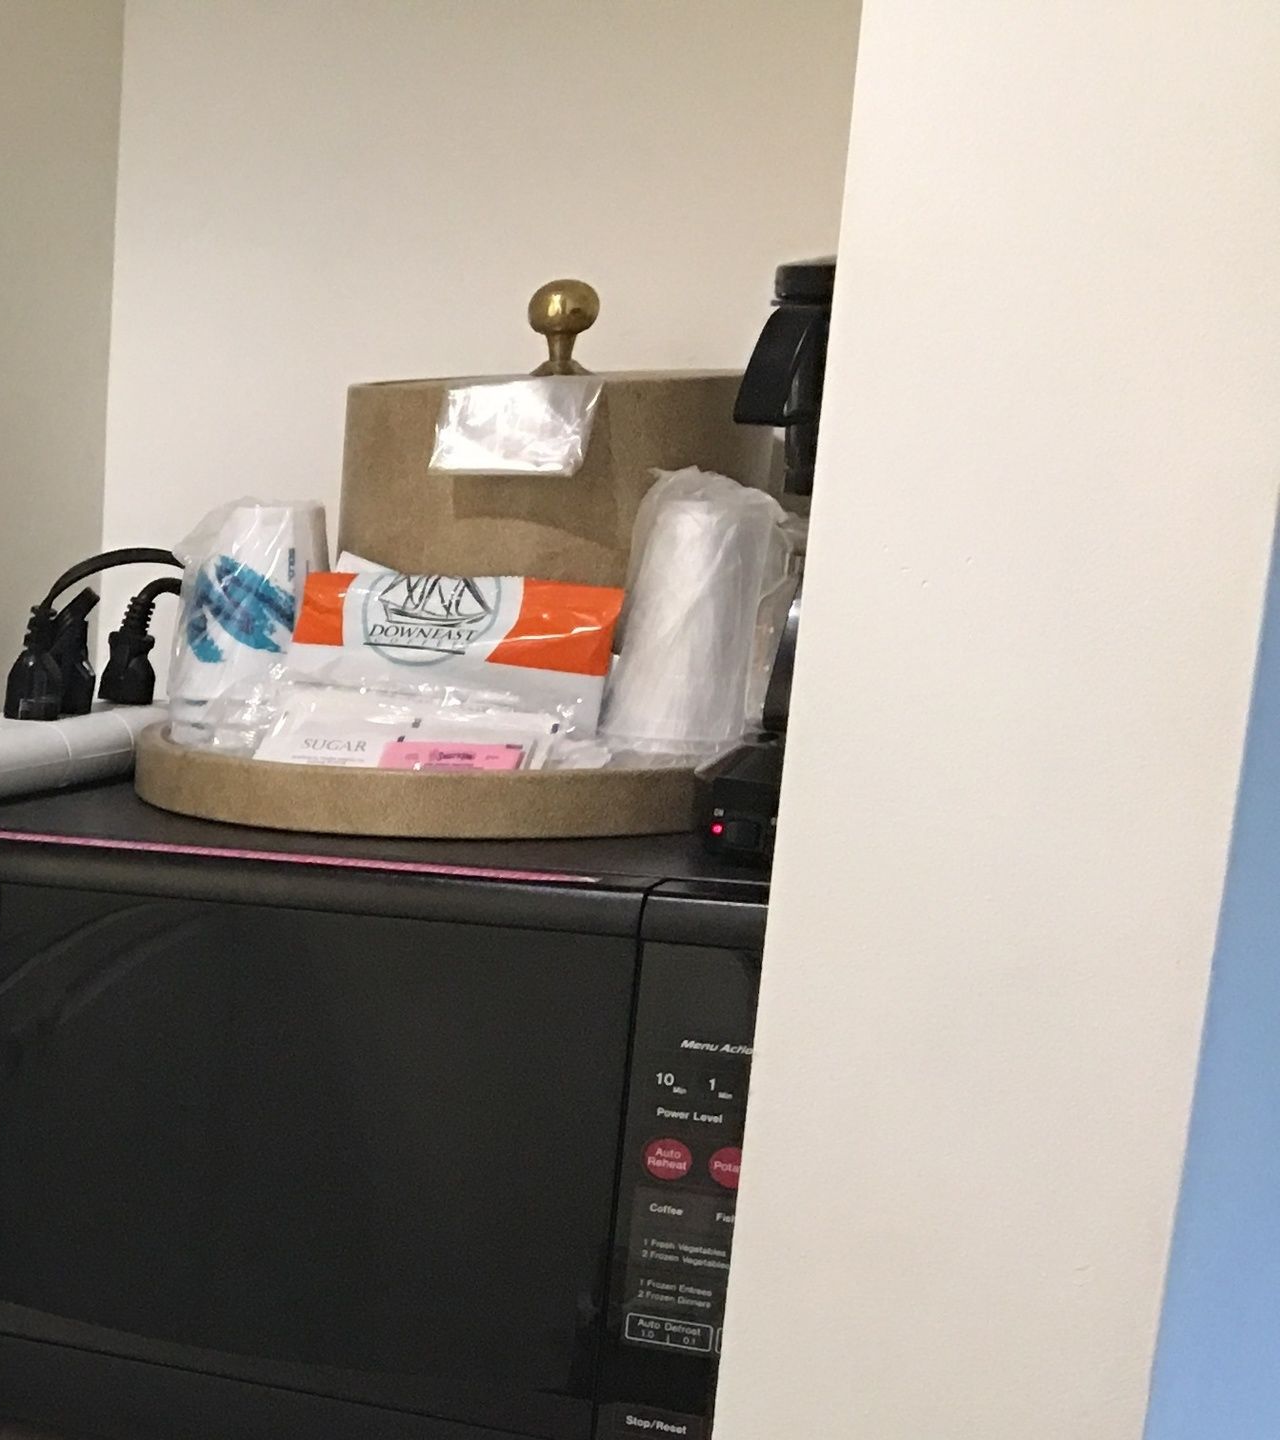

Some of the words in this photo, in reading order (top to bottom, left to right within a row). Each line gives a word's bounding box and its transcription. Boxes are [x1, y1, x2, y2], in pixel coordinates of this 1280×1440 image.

[369, 623, 478, 641] DOWNEAST
[304, 737, 367, 753] SUGAR
[680, 1039, 719, 1052] Menu
[656, 1072, 675, 1086] 10
[709, 1078, 717, 1091] 1
[656, 1106, 690, 1119] Power
[693, 1112, 723, 1123] Level
[655, 1147, 682, 1159] Auto
[647, 1156, 687, 1171] Reheat
[649, 1203, 684, 1216] Coffee
[642, 1249, 648, 1258] 2
[650, 1250, 680, 1262] Frozen
[647, 1279, 677, 1291] Frozen
[637, 1290, 644, 1298] 2
[645, 1290, 675, 1302] Frozen
[637, 1318, 661, 1330] Auto
[664, 1322, 702, 1336] Defrost
[625, 1415, 687, 1435] Stop/Reset
